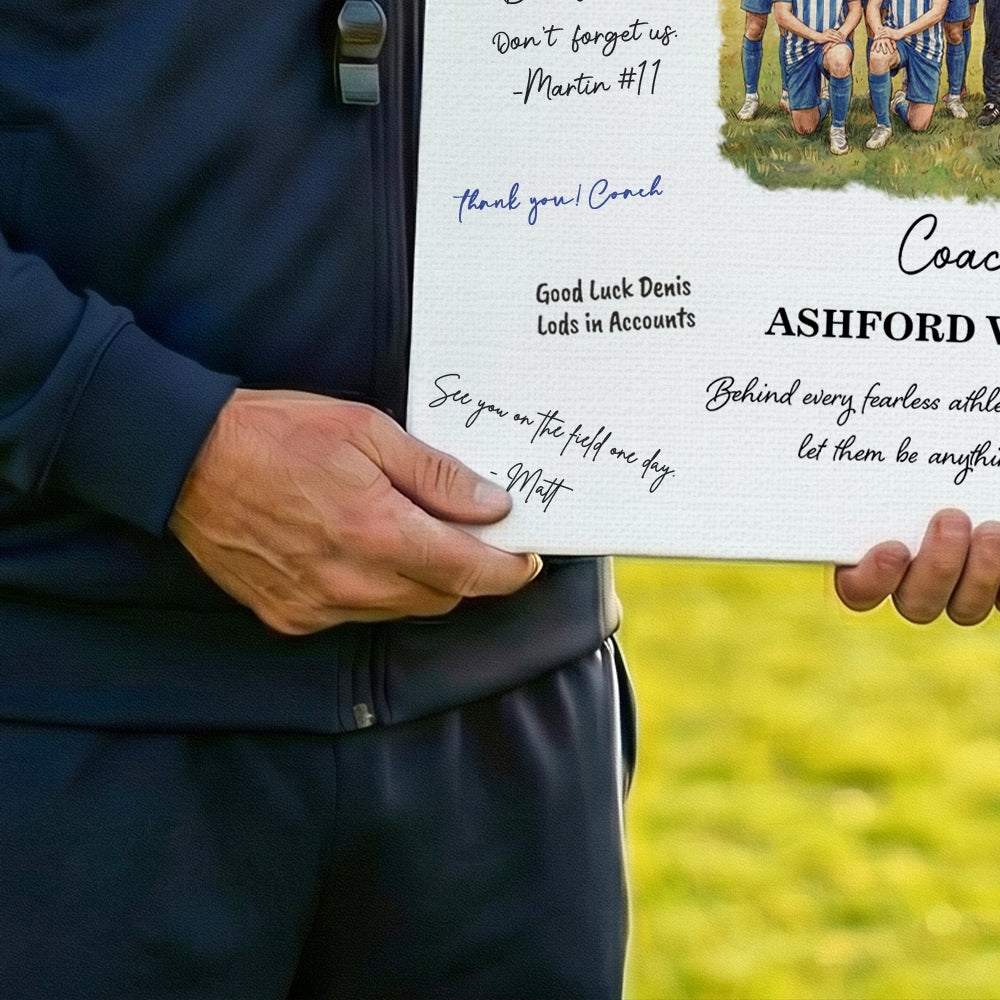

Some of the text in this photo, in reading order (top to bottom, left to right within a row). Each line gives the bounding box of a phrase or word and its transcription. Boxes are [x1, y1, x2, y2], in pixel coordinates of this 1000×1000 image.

[491, 18, 677, 58] Don't forget us.
[512, 58, 662, 105] -Martin #11
[452, 174, 664, 226] thank you! Coach
[535, 274, 692, 306] Good Luck Denis
[537, 306, 697, 337] Lods in Accounts
[763, 306, 976, 344] ASHFORD
[704, 375, 802, 413] Behind
[801, 388, 857, 427] every
[860, 381, 941, 415] fearless
[428, 373, 676, 494] See you on the field one day.
[797, 432, 829, 462] let
[832, 434, 886, 463] them
[895, 435, 919, 464] be
[505, 462, 574, 514] Matt
